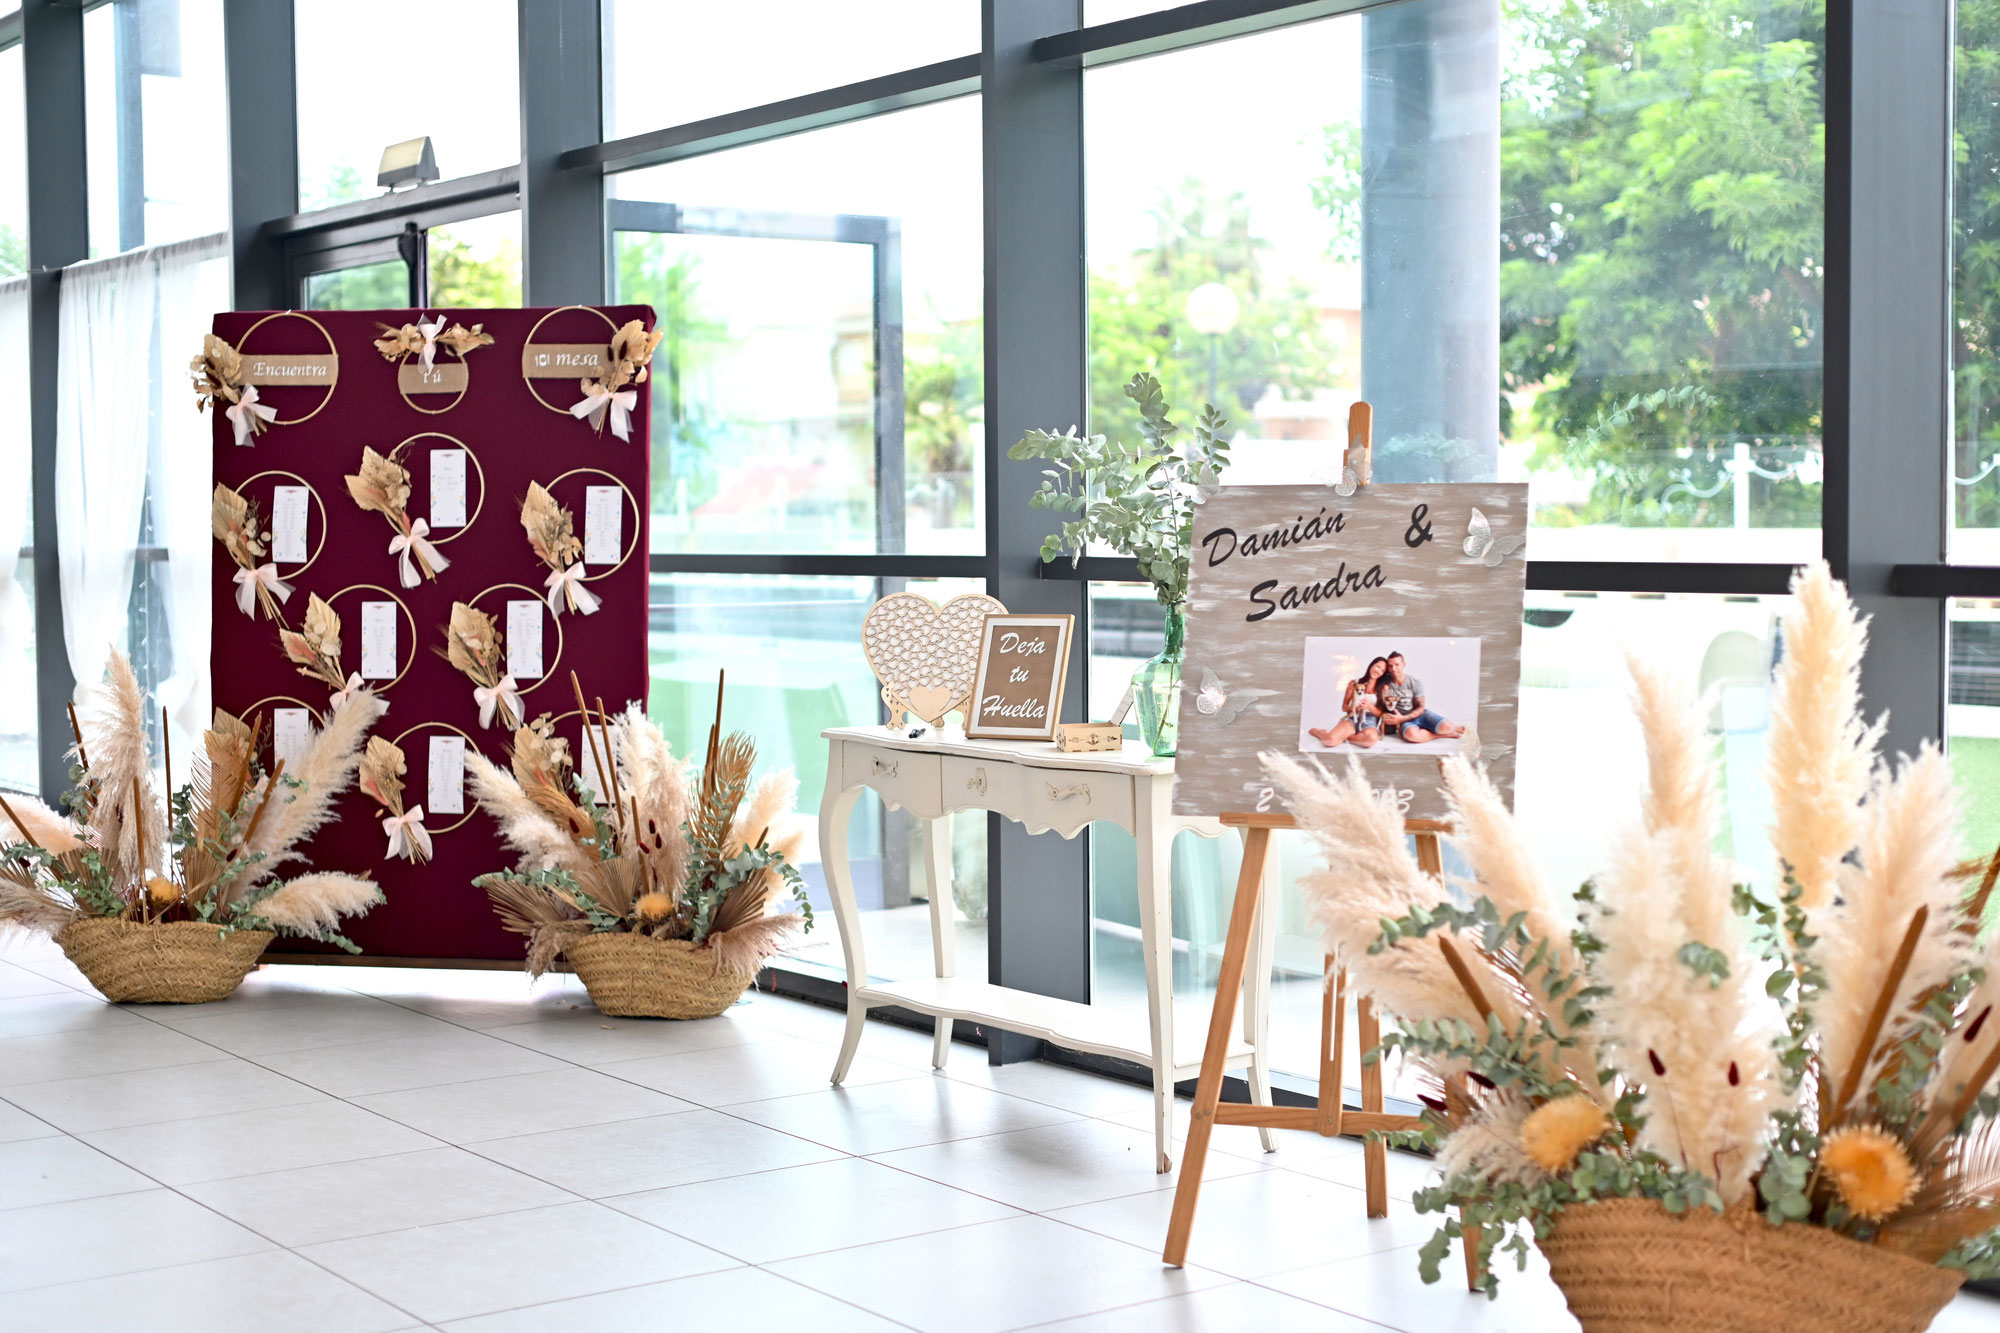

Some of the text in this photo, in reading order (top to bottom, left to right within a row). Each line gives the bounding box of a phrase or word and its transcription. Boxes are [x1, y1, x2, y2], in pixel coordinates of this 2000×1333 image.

[253, 361, 327, 377] Encuentra
[556, 353, 599, 366] mesa
[1202, 503, 1433, 567] Damián &
[1246, 562, 1387, 622] Sandra
[999, 632, 1046, 657] Deja
[1009, 665, 1030, 683] tu
[982, 694, 1045, 719] Huella
